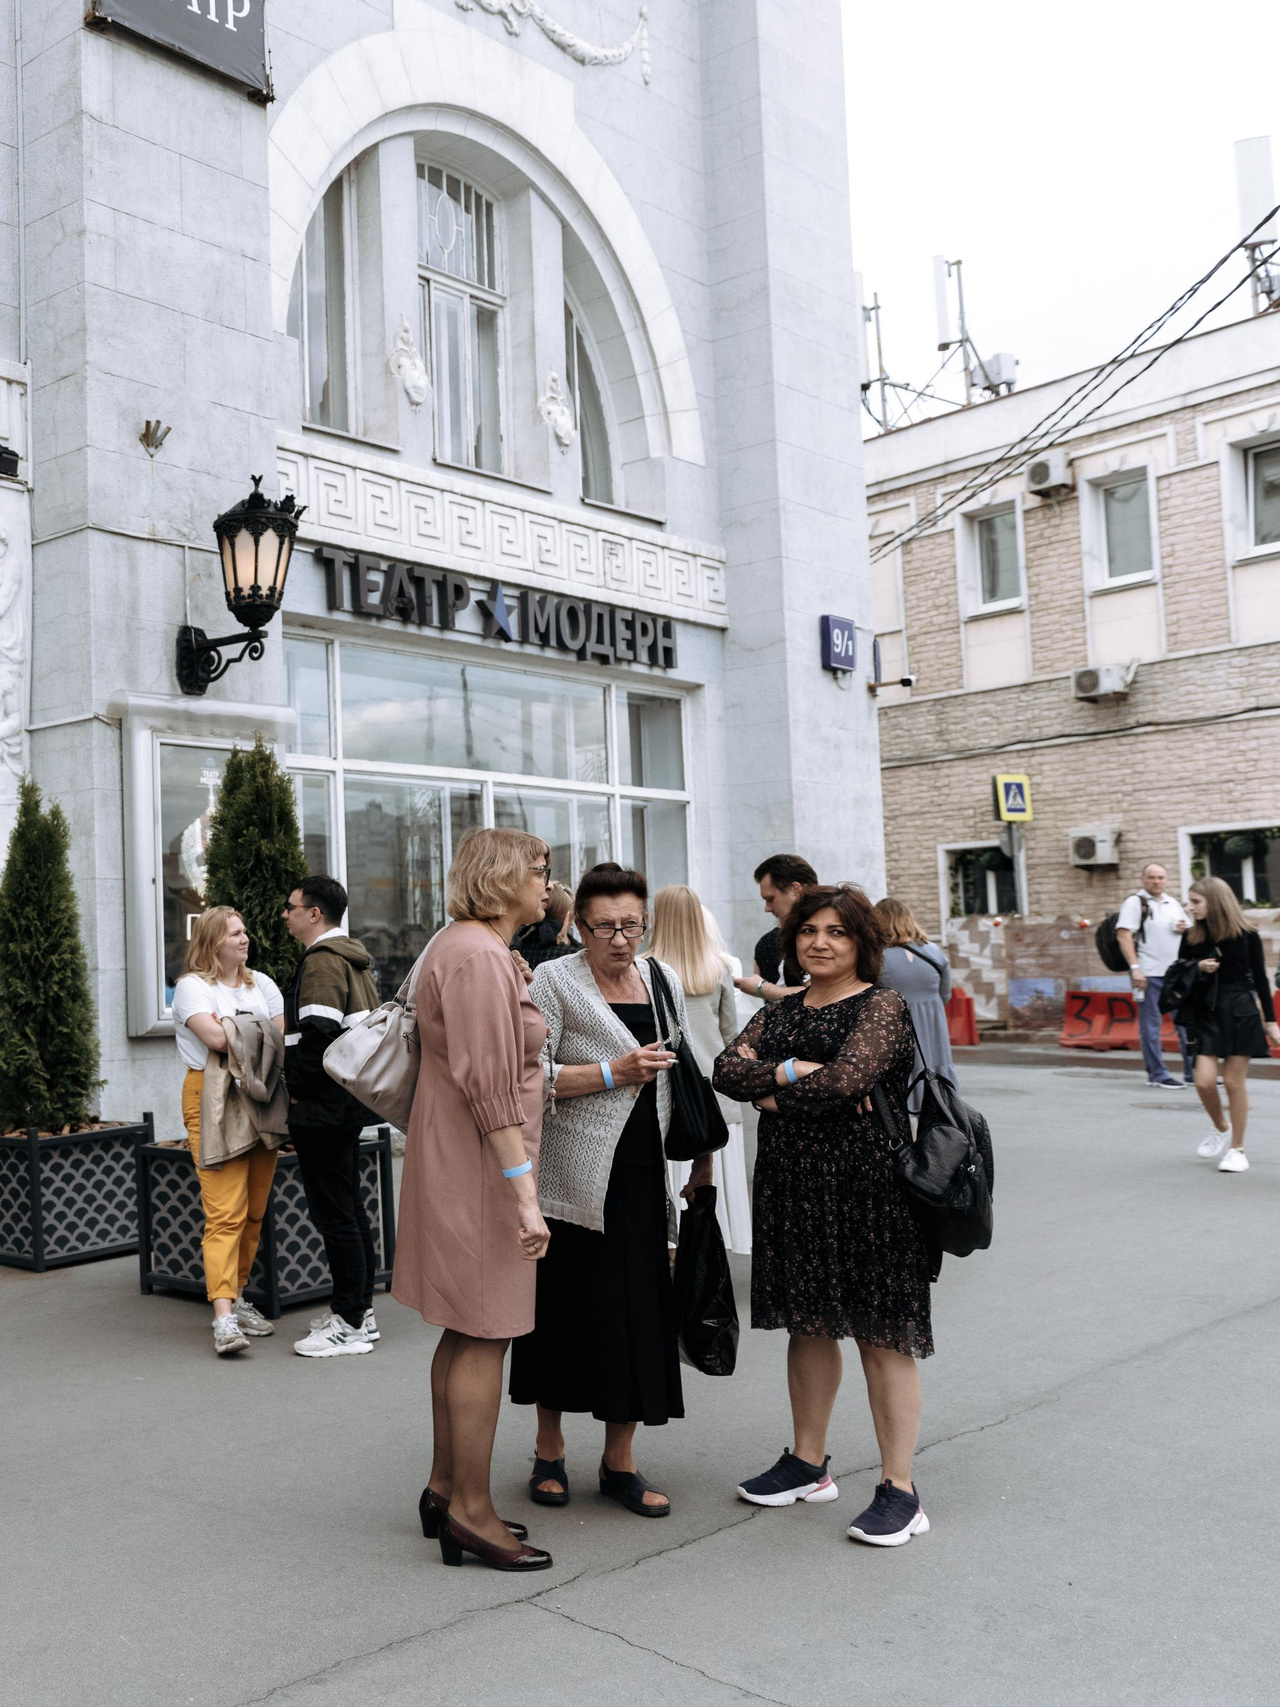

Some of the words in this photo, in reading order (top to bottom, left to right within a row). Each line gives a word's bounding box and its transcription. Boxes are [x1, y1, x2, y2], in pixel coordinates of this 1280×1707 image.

[314, 546, 471, 630] ТЕАТР
[519, 589, 679, 670] МОДЕРН
[833, 628, 854, 657] 9/1
